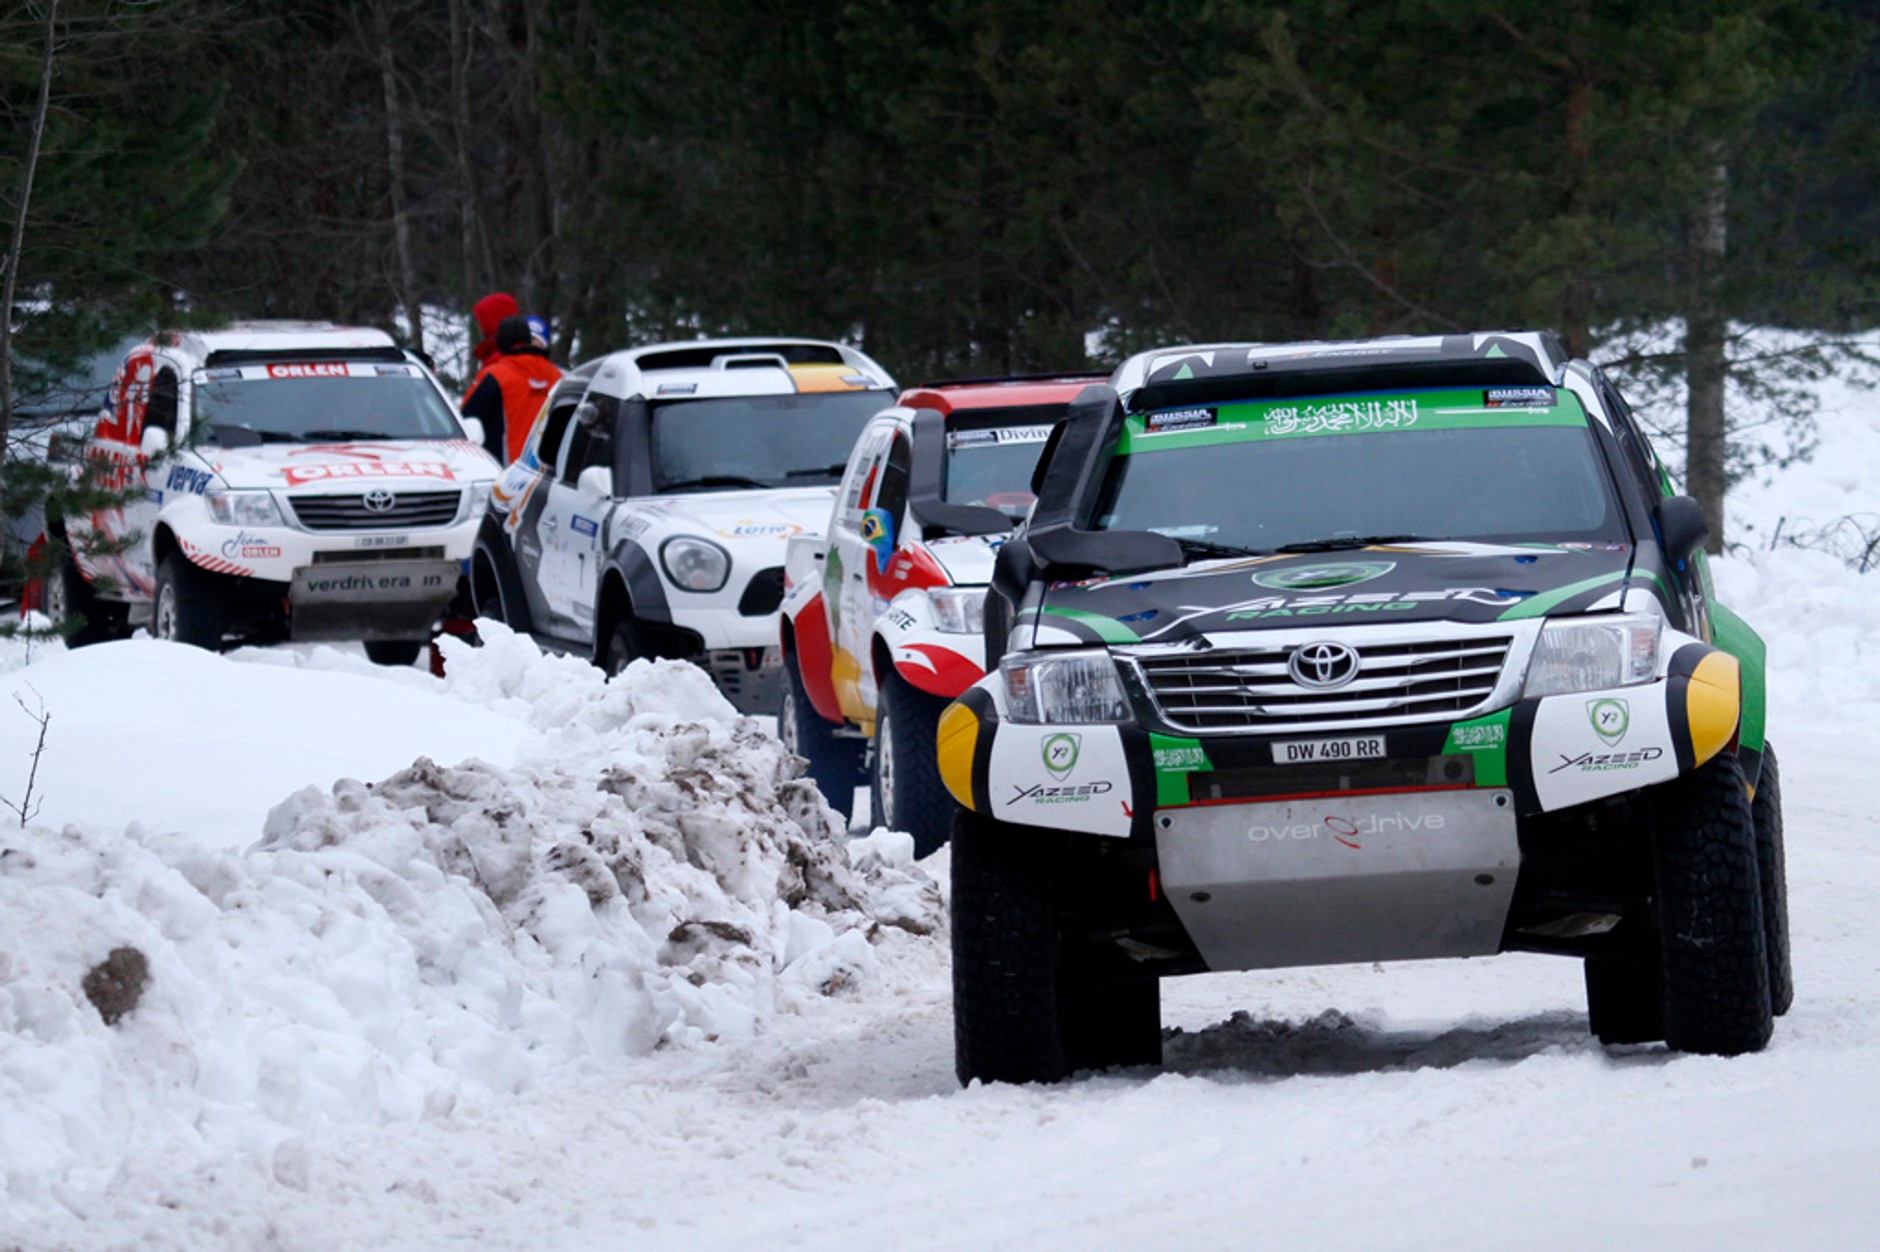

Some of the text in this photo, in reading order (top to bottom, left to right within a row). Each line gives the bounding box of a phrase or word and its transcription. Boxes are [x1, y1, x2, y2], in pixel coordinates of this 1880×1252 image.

[271, 364, 347, 378] ORLEN
[166, 464, 214, 496] verva
[289, 463, 450, 481] ORLEN
[1226, 601, 1419, 622] RACING
[1287, 740, 1381, 760] DW 490 RR
[1548, 747, 1663, 774] YAZEED
[1580, 761, 1639, 772] RACING
[1006, 781, 1113, 805] YAZEED
[1035, 795, 1089, 804] RACING
